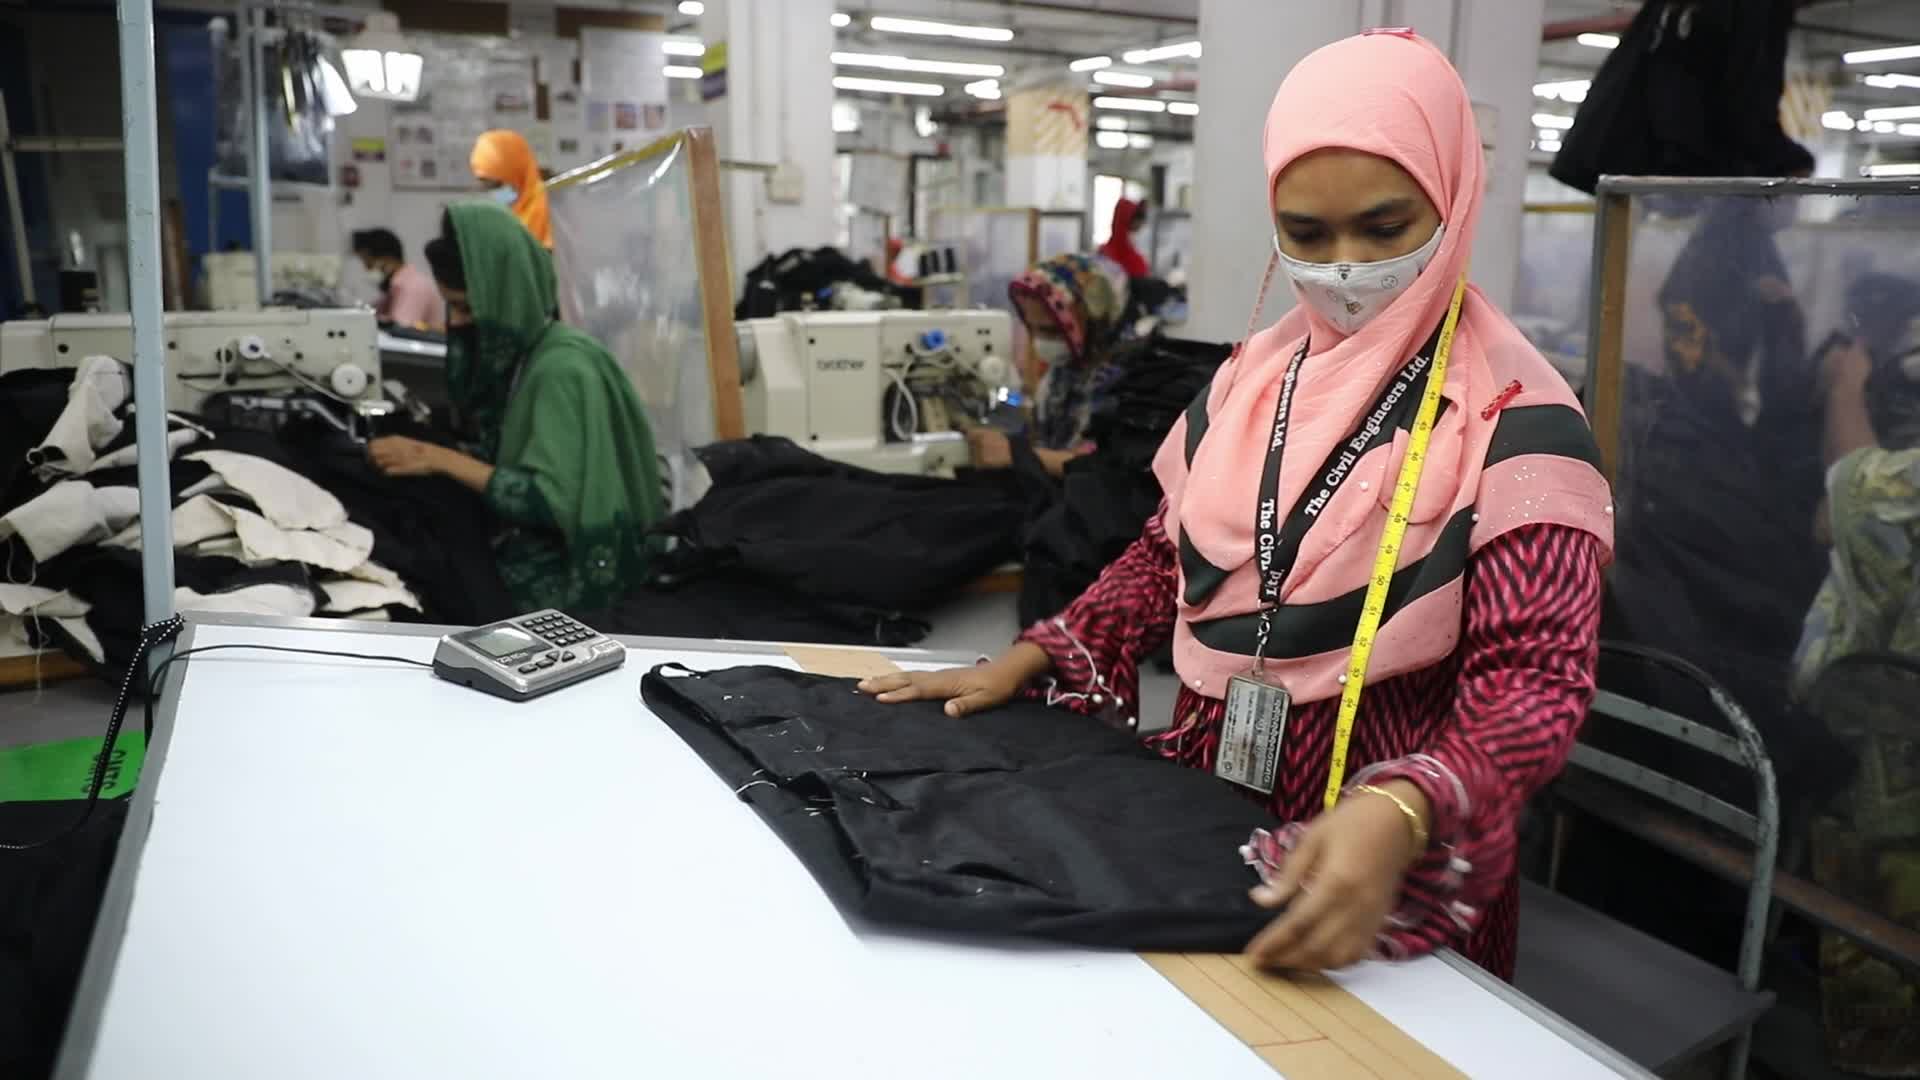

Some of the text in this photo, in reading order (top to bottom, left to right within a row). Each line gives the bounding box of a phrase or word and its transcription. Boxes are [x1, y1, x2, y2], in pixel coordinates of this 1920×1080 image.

[1270, 422, 1286, 451] Ltd.
[1304, 355, 1430, 518] The Civil Engineers Ltd.
[1410, 451, 1419, 461] 46
[1402, 480, 1411, 492] 47
[1260, 498, 1275, 530] The
[1392, 511, 1402, 524] 48
[1376, 574, 1385, 586] 50
[1368, 605, 1376, 616] 51
[1358, 636, 1368, 647] 52
[1351, 666, 1360, 678] 53
[1345, 697, 1353, 708] 54
